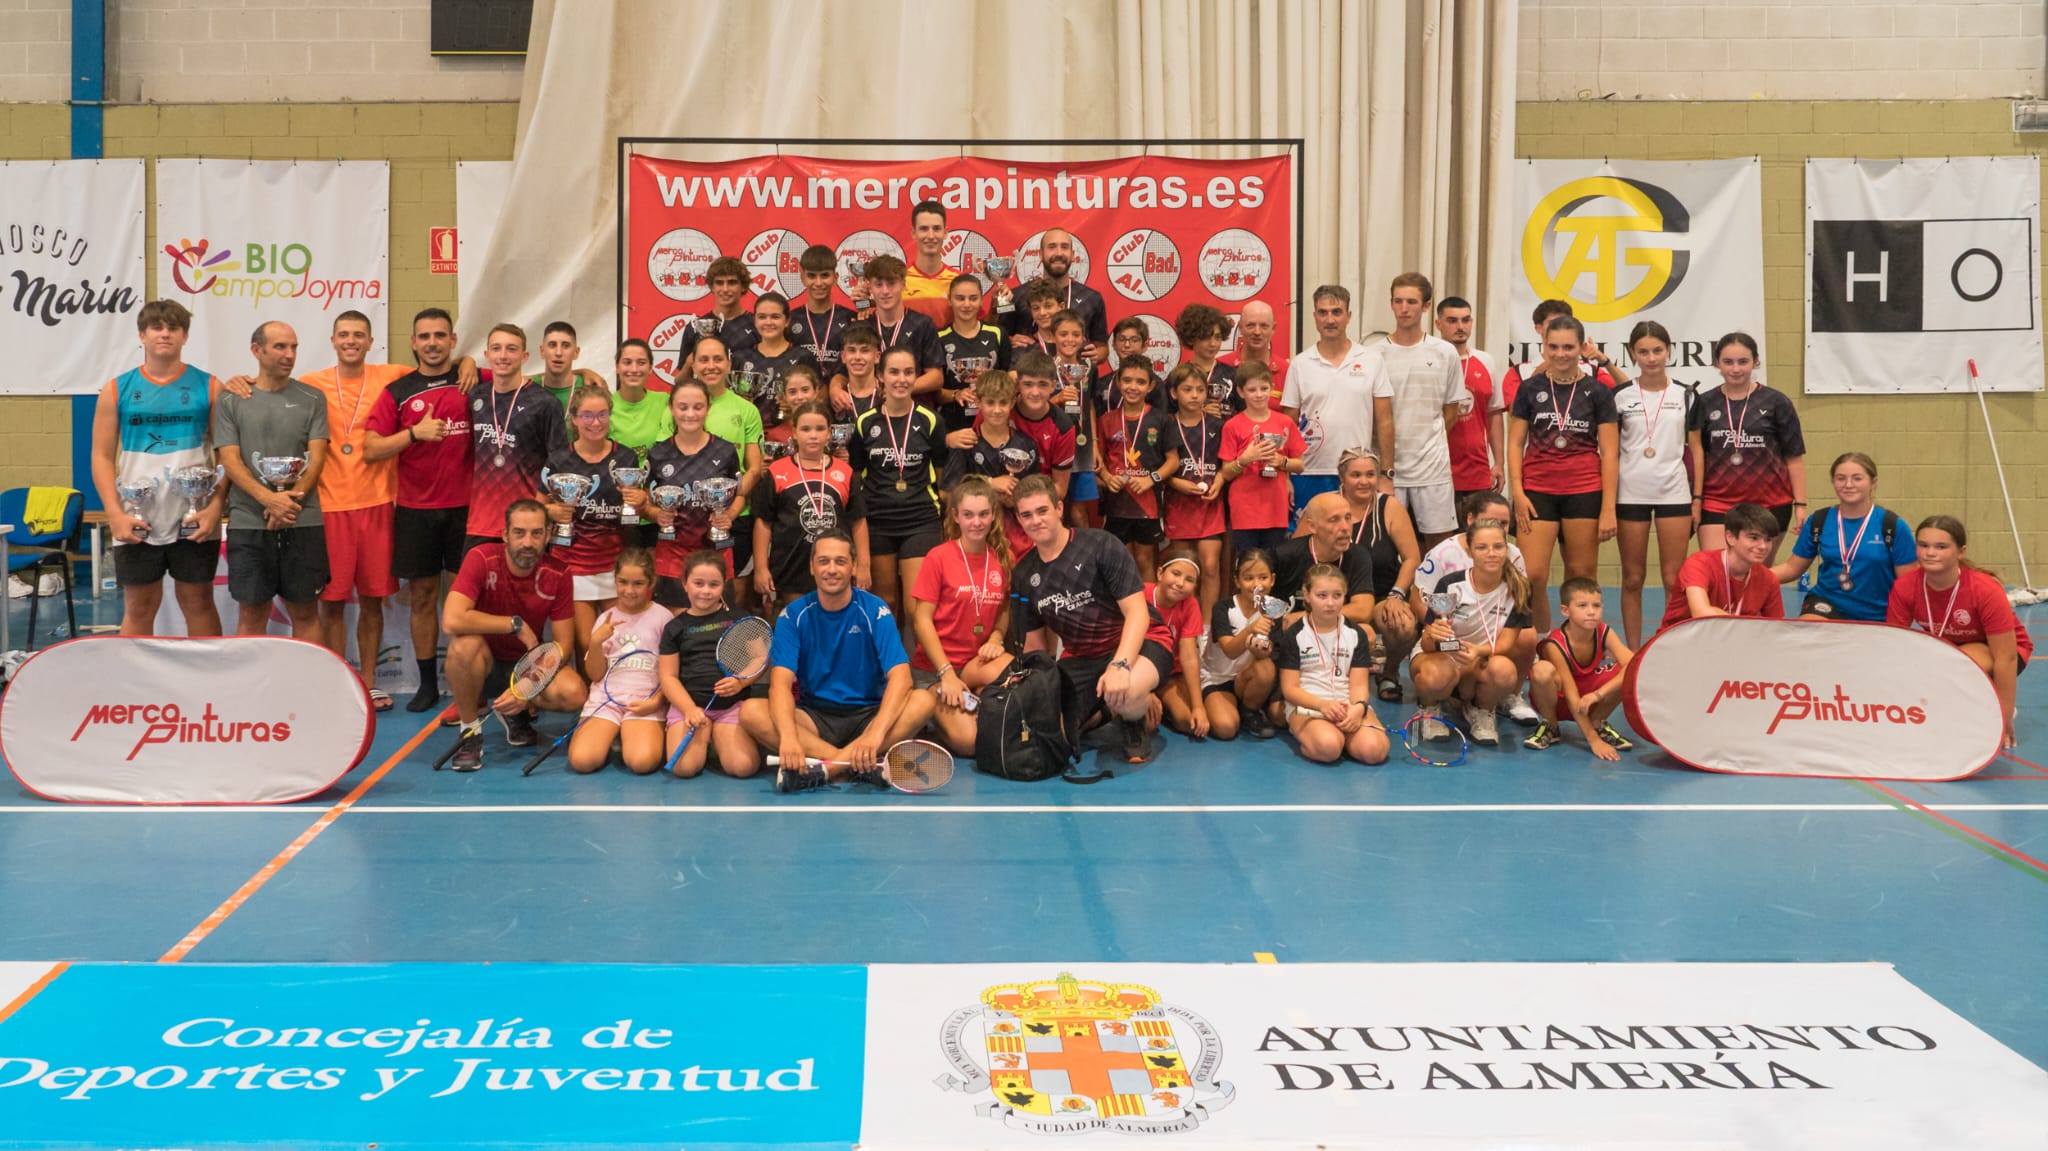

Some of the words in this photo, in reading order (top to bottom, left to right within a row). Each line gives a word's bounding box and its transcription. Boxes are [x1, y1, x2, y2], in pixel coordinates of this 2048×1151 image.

[656, 167, 1265, 221] www.mercapinturas.es
[246, 243, 312, 275] BIO
[746, 233, 779, 263] Club
[1113, 233, 1145, 263] Club
[1145, 252, 1178, 273] Bad.
[1115, 273, 1143, 295] Al.
[1846, 251, 1889, 302] H
[1951, 248, 2003, 302] O
[653, 319, 686, 348] Club
[146, 414, 193, 425] cajamar
[1706, 680, 1811, 713] Merca
[1766, 684, 1927, 735] Pinturas
[70, 703, 180, 742] Merca
[126, 703, 291, 761] Pinturas
[162, 1018, 553, 1057] Concejalía
[582, 1019, 673, 1049] de
[1253, 1024, 1938, 1051] AYUNTAMIENTO
[0, 1057, 346, 1100] Deportes
[360, 1068, 424, 1101] y
[430, 1058, 820, 1098] Juventud
[1263, 1063, 1395, 1091] DE
[1420, 1051, 1833, 1091] ALMERÍA
[1090, 1120, 1112, 1129] DE
